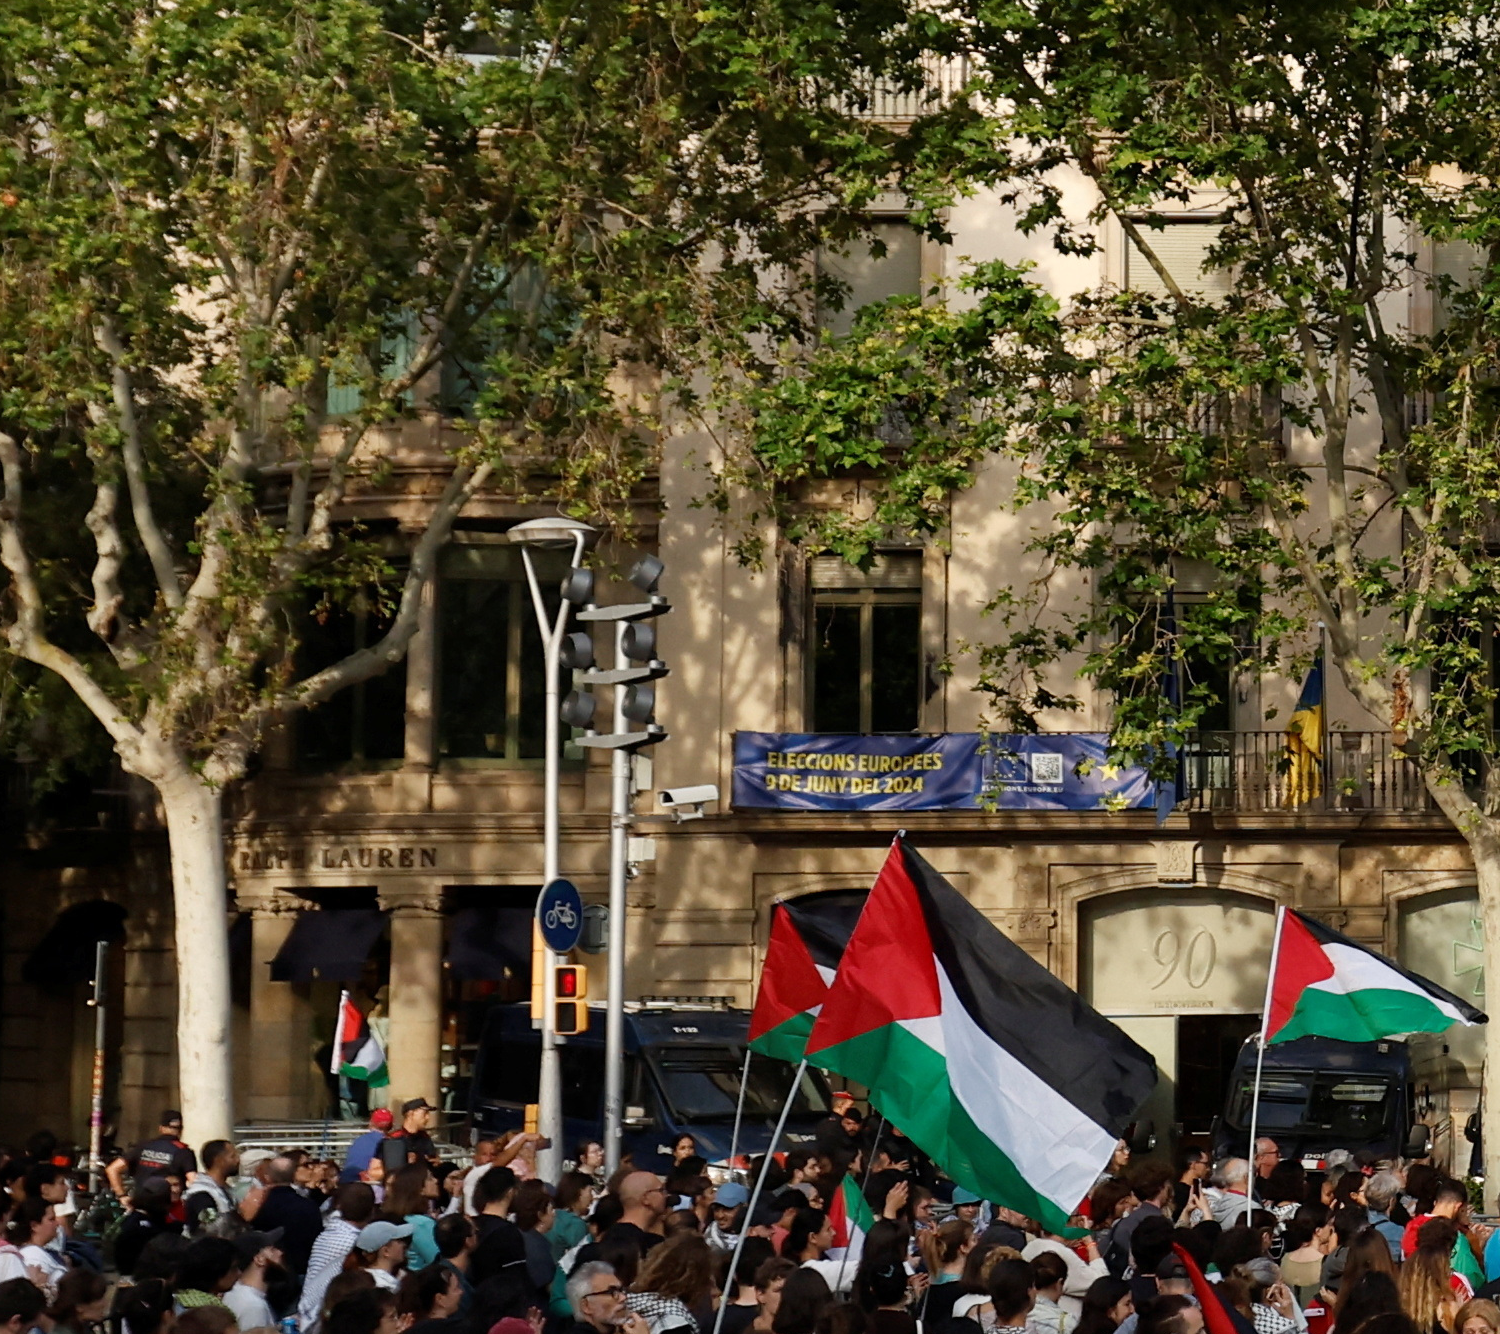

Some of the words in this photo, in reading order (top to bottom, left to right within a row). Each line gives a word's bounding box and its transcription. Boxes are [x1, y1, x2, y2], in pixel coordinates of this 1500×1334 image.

[767, 752, 855, 771] ELECCIONS
[858, 752, 943, 772] EUROPEES
[766, 774, 776, 790] 9
[779, 774, 801, 792] DE
[804, 776, 848, 793] JUNY
[851, 777, 881, 794] DEL
[884, 776, 924, 793] 2024
[239, 849, 305, 870] RALPH
[322, 847, 436, 868] LAUREN
[1151, 927, 1217, 990] 90
